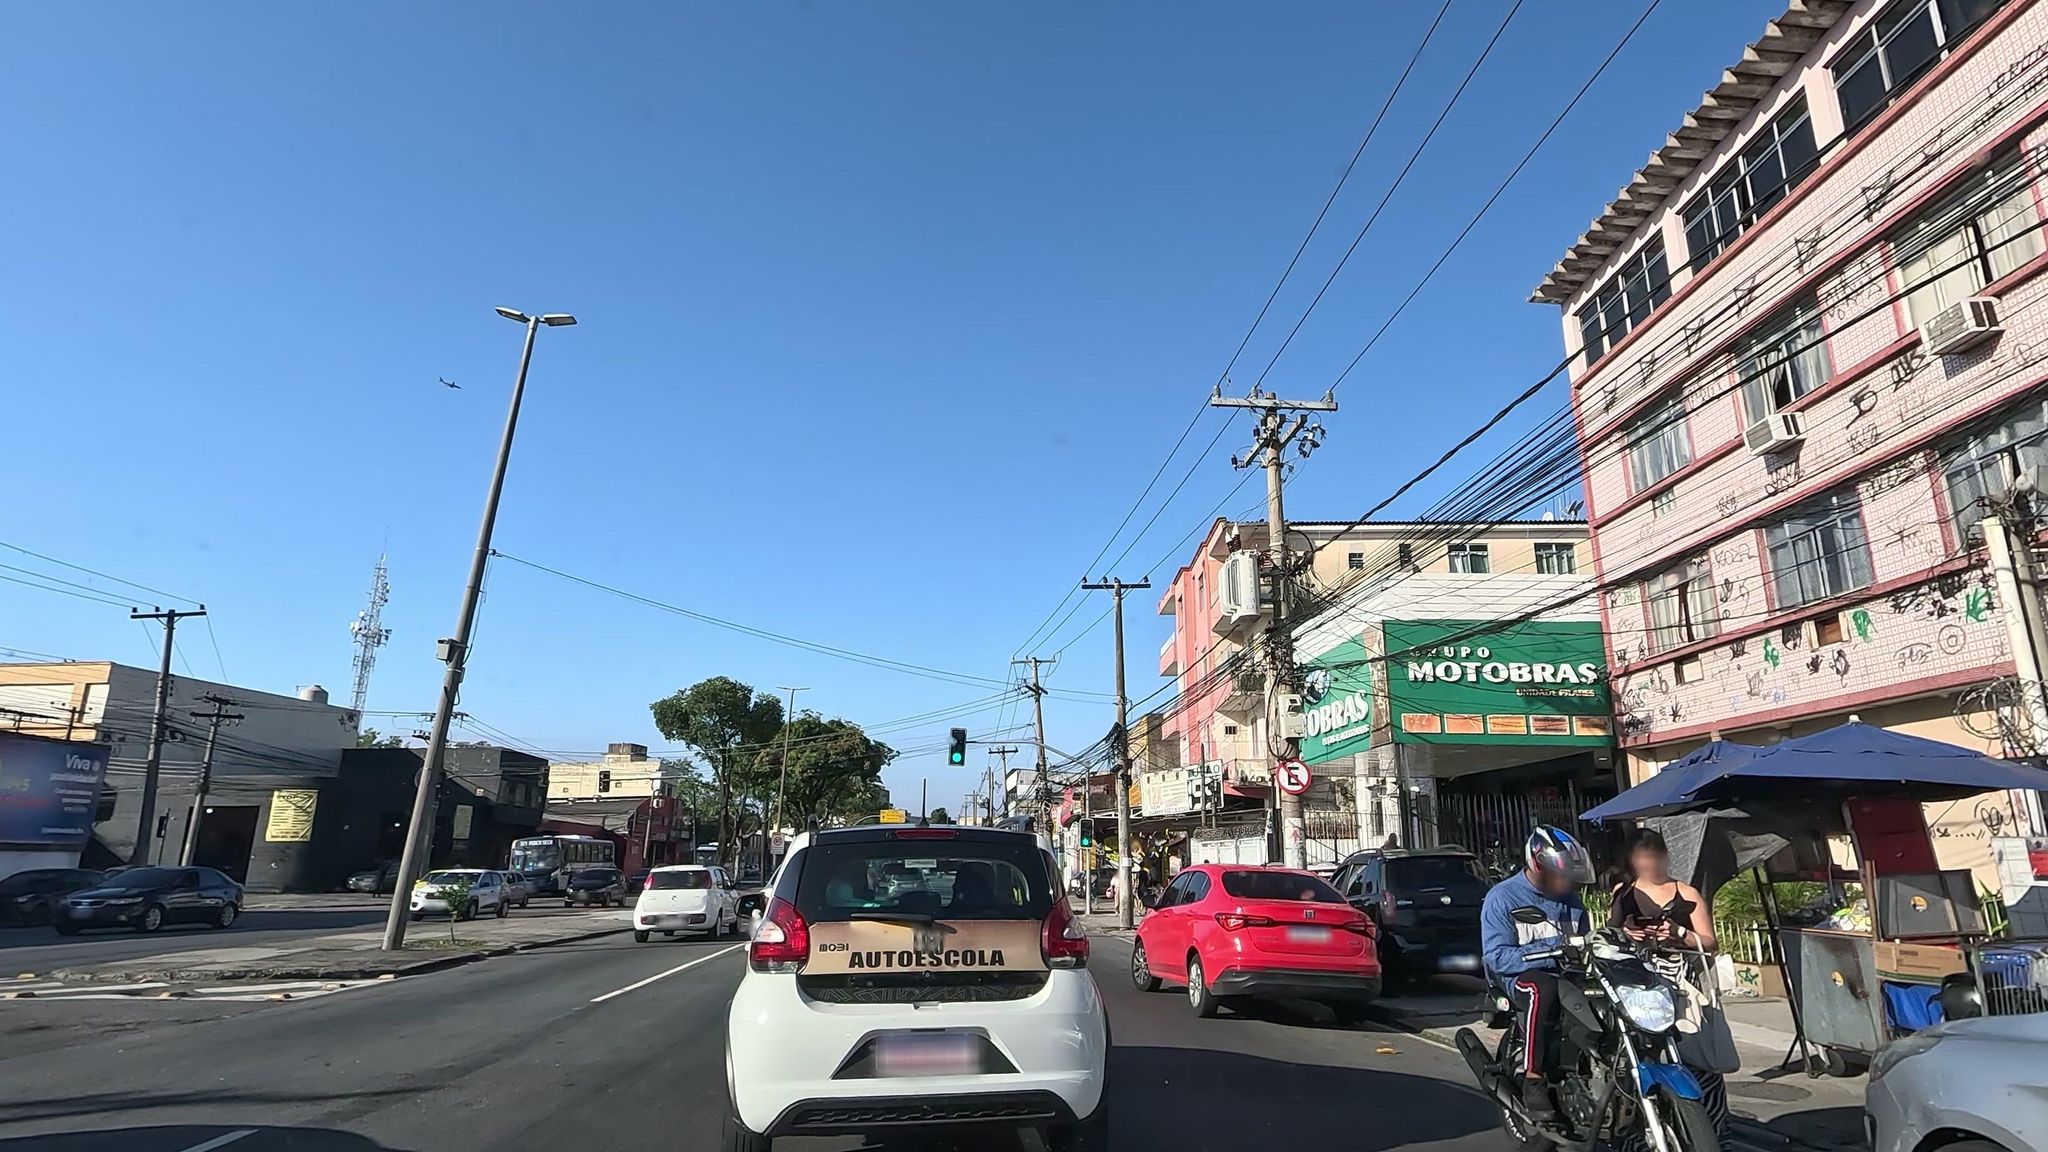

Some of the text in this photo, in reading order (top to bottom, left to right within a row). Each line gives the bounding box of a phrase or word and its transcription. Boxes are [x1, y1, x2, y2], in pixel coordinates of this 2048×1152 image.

[1408, 661, 1598, 683] MOTOBRAS
[66, 754, 90, 770] Viva
[1288, 766, 1300, 786] E
[848, 949, 1005, 968] AUTOESCOLA
